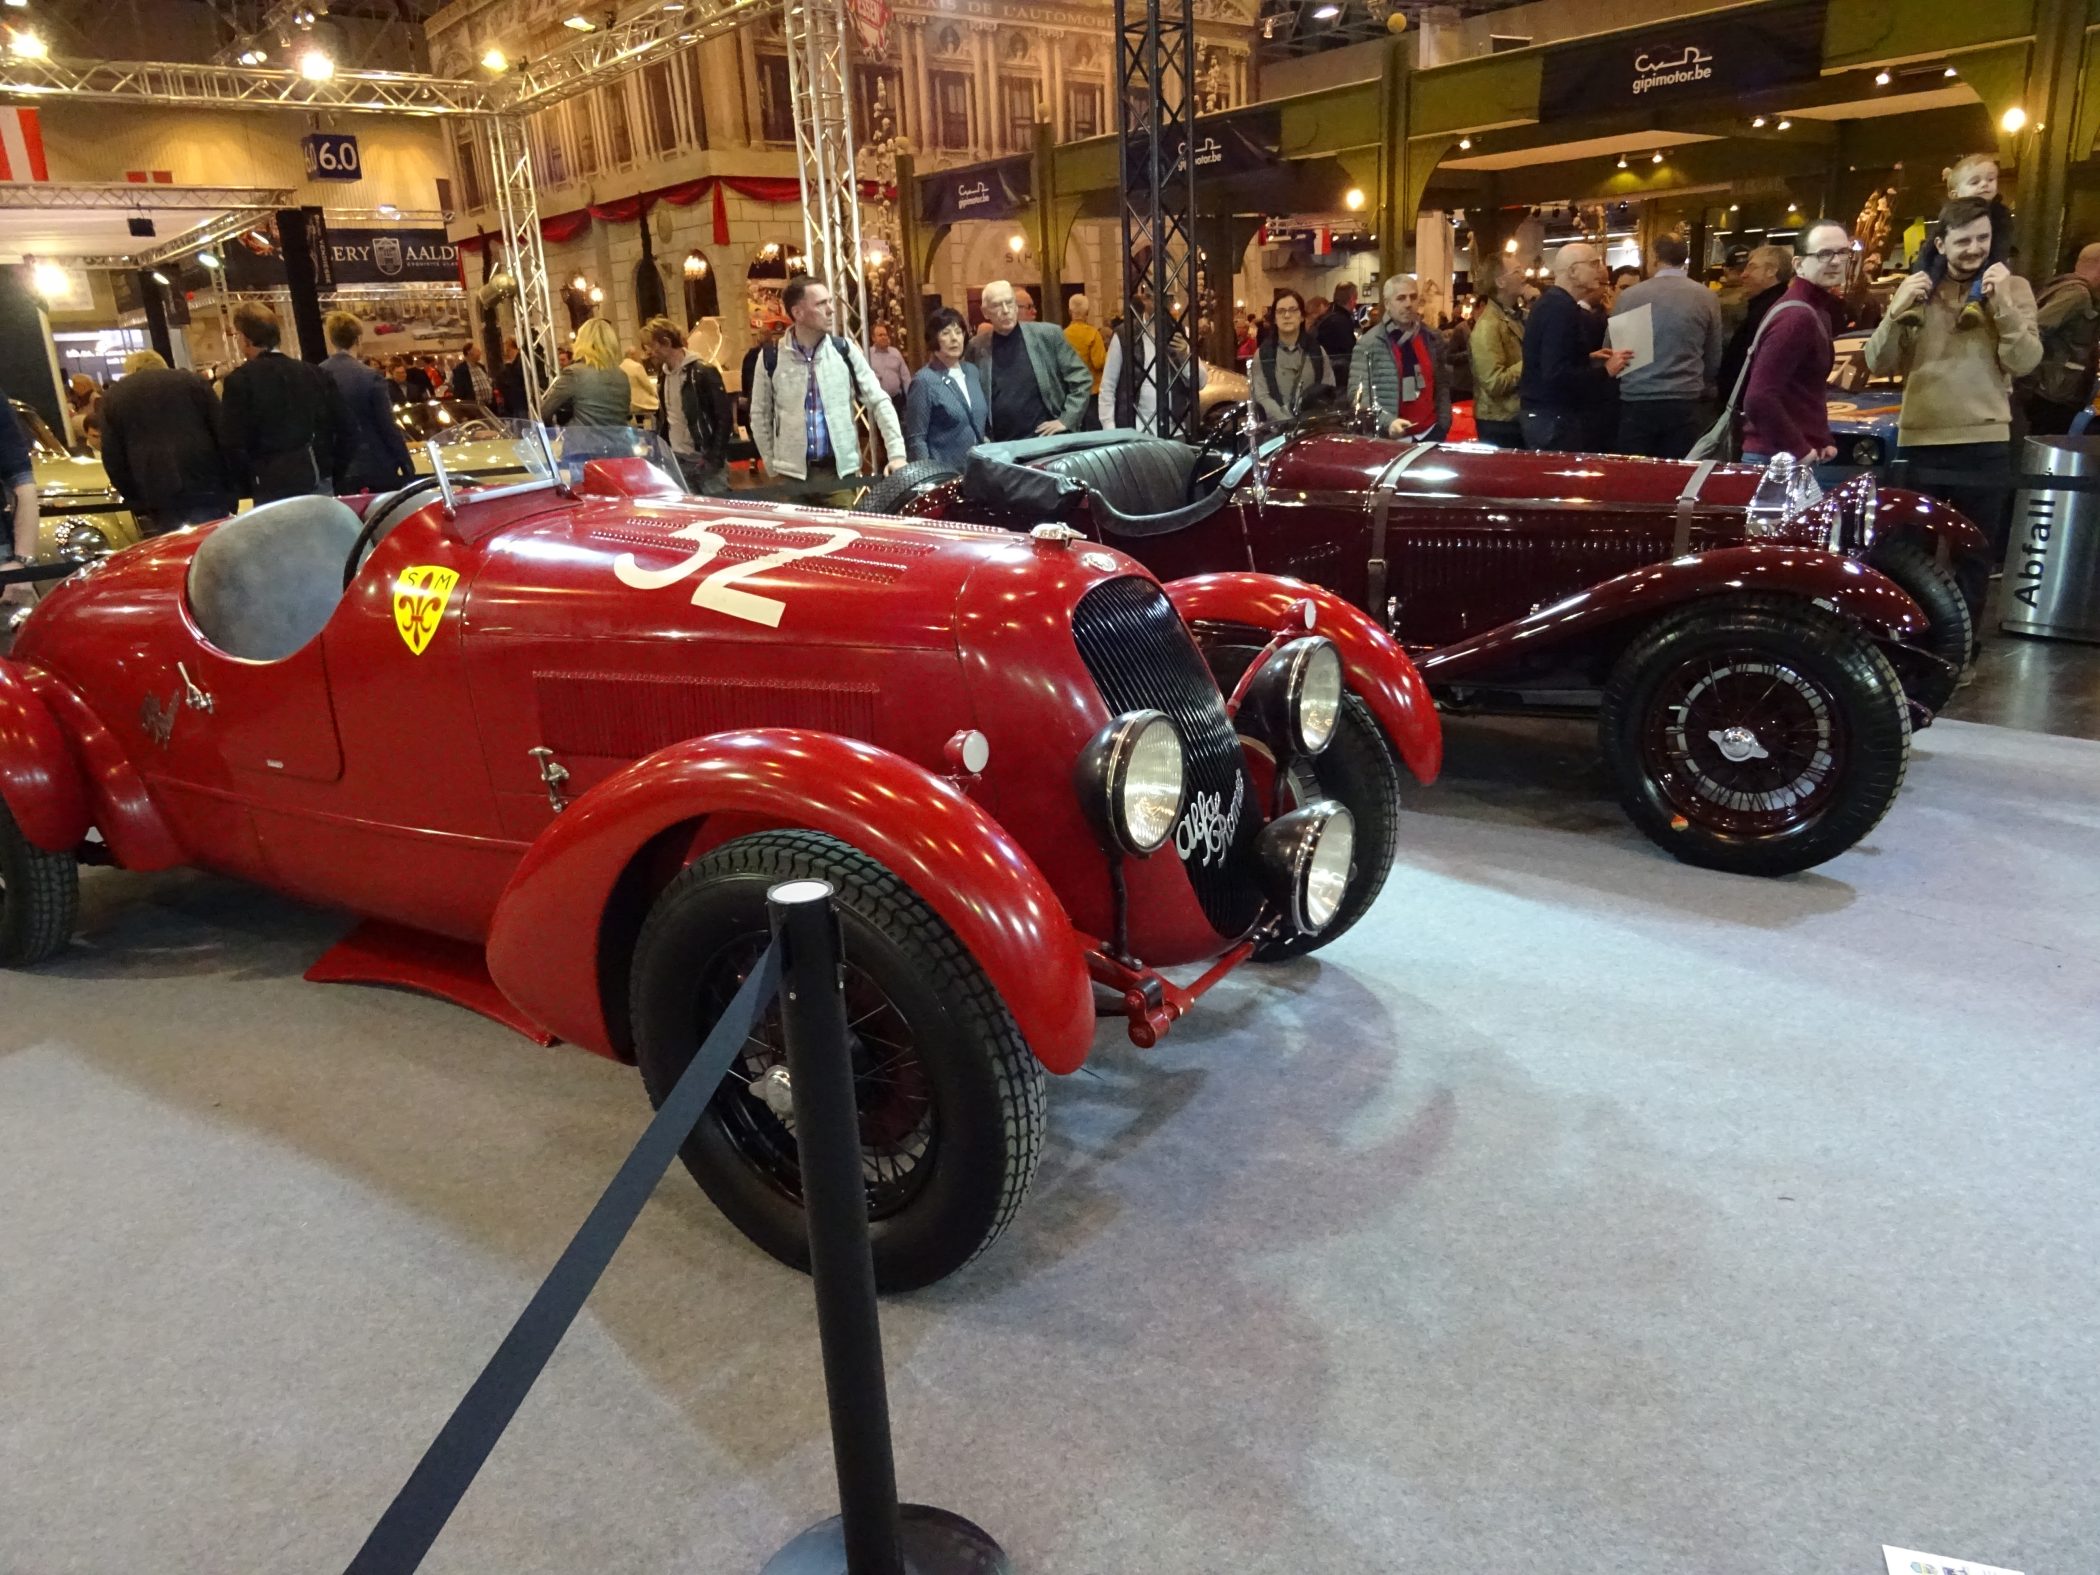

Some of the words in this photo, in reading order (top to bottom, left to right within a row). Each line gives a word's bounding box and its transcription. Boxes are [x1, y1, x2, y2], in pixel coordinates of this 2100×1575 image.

[968, 3, 992, 15] DE
[1632, 63, 1712, 94] gipimotor.be
[319, 142, 357, 170] 6.0
[2013, 499, 2056, 609] Abfall
[434, 574, 453, 590] M
[613, 516, 863, 628] 52
